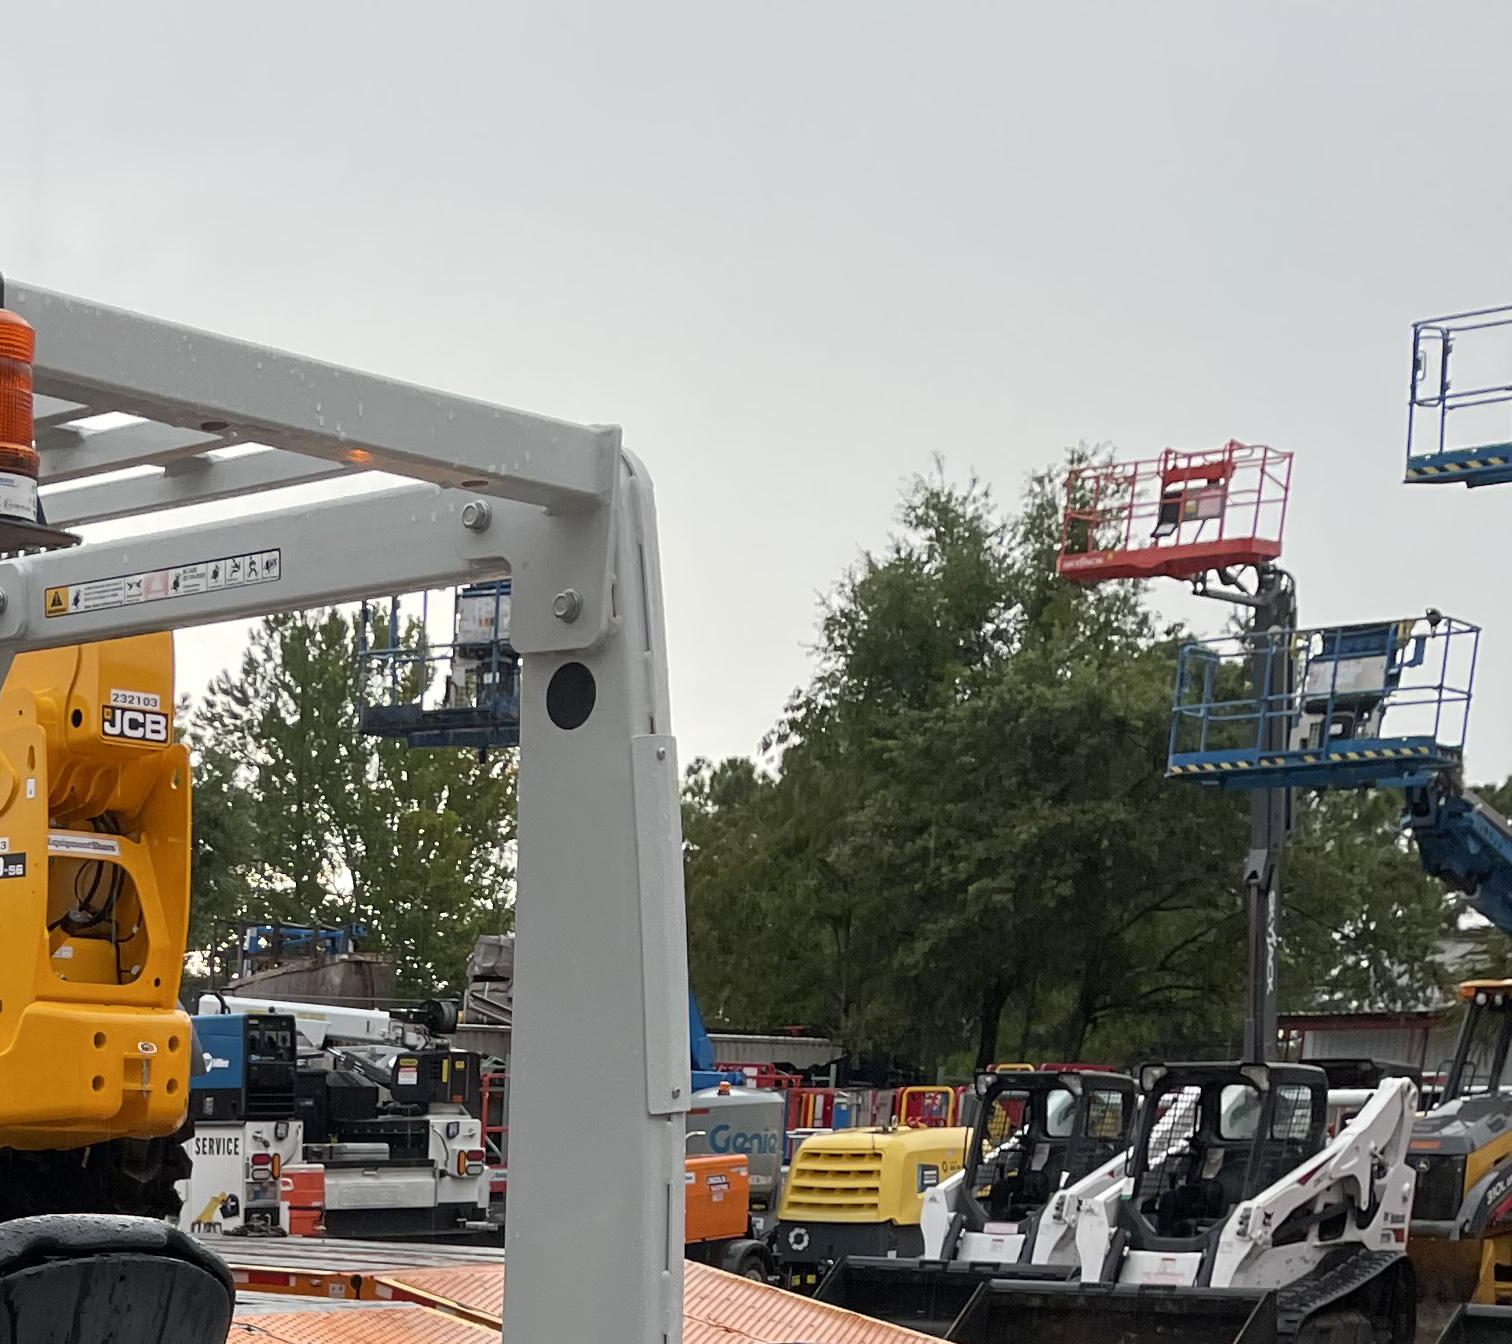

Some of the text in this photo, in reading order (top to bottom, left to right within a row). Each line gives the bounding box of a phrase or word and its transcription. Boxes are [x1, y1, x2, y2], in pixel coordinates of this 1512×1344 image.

[112, 692, 159, 708] 232103
[103, 708, 167, 741] JCB
[194, 1137, 240, 1156] SERVICE
